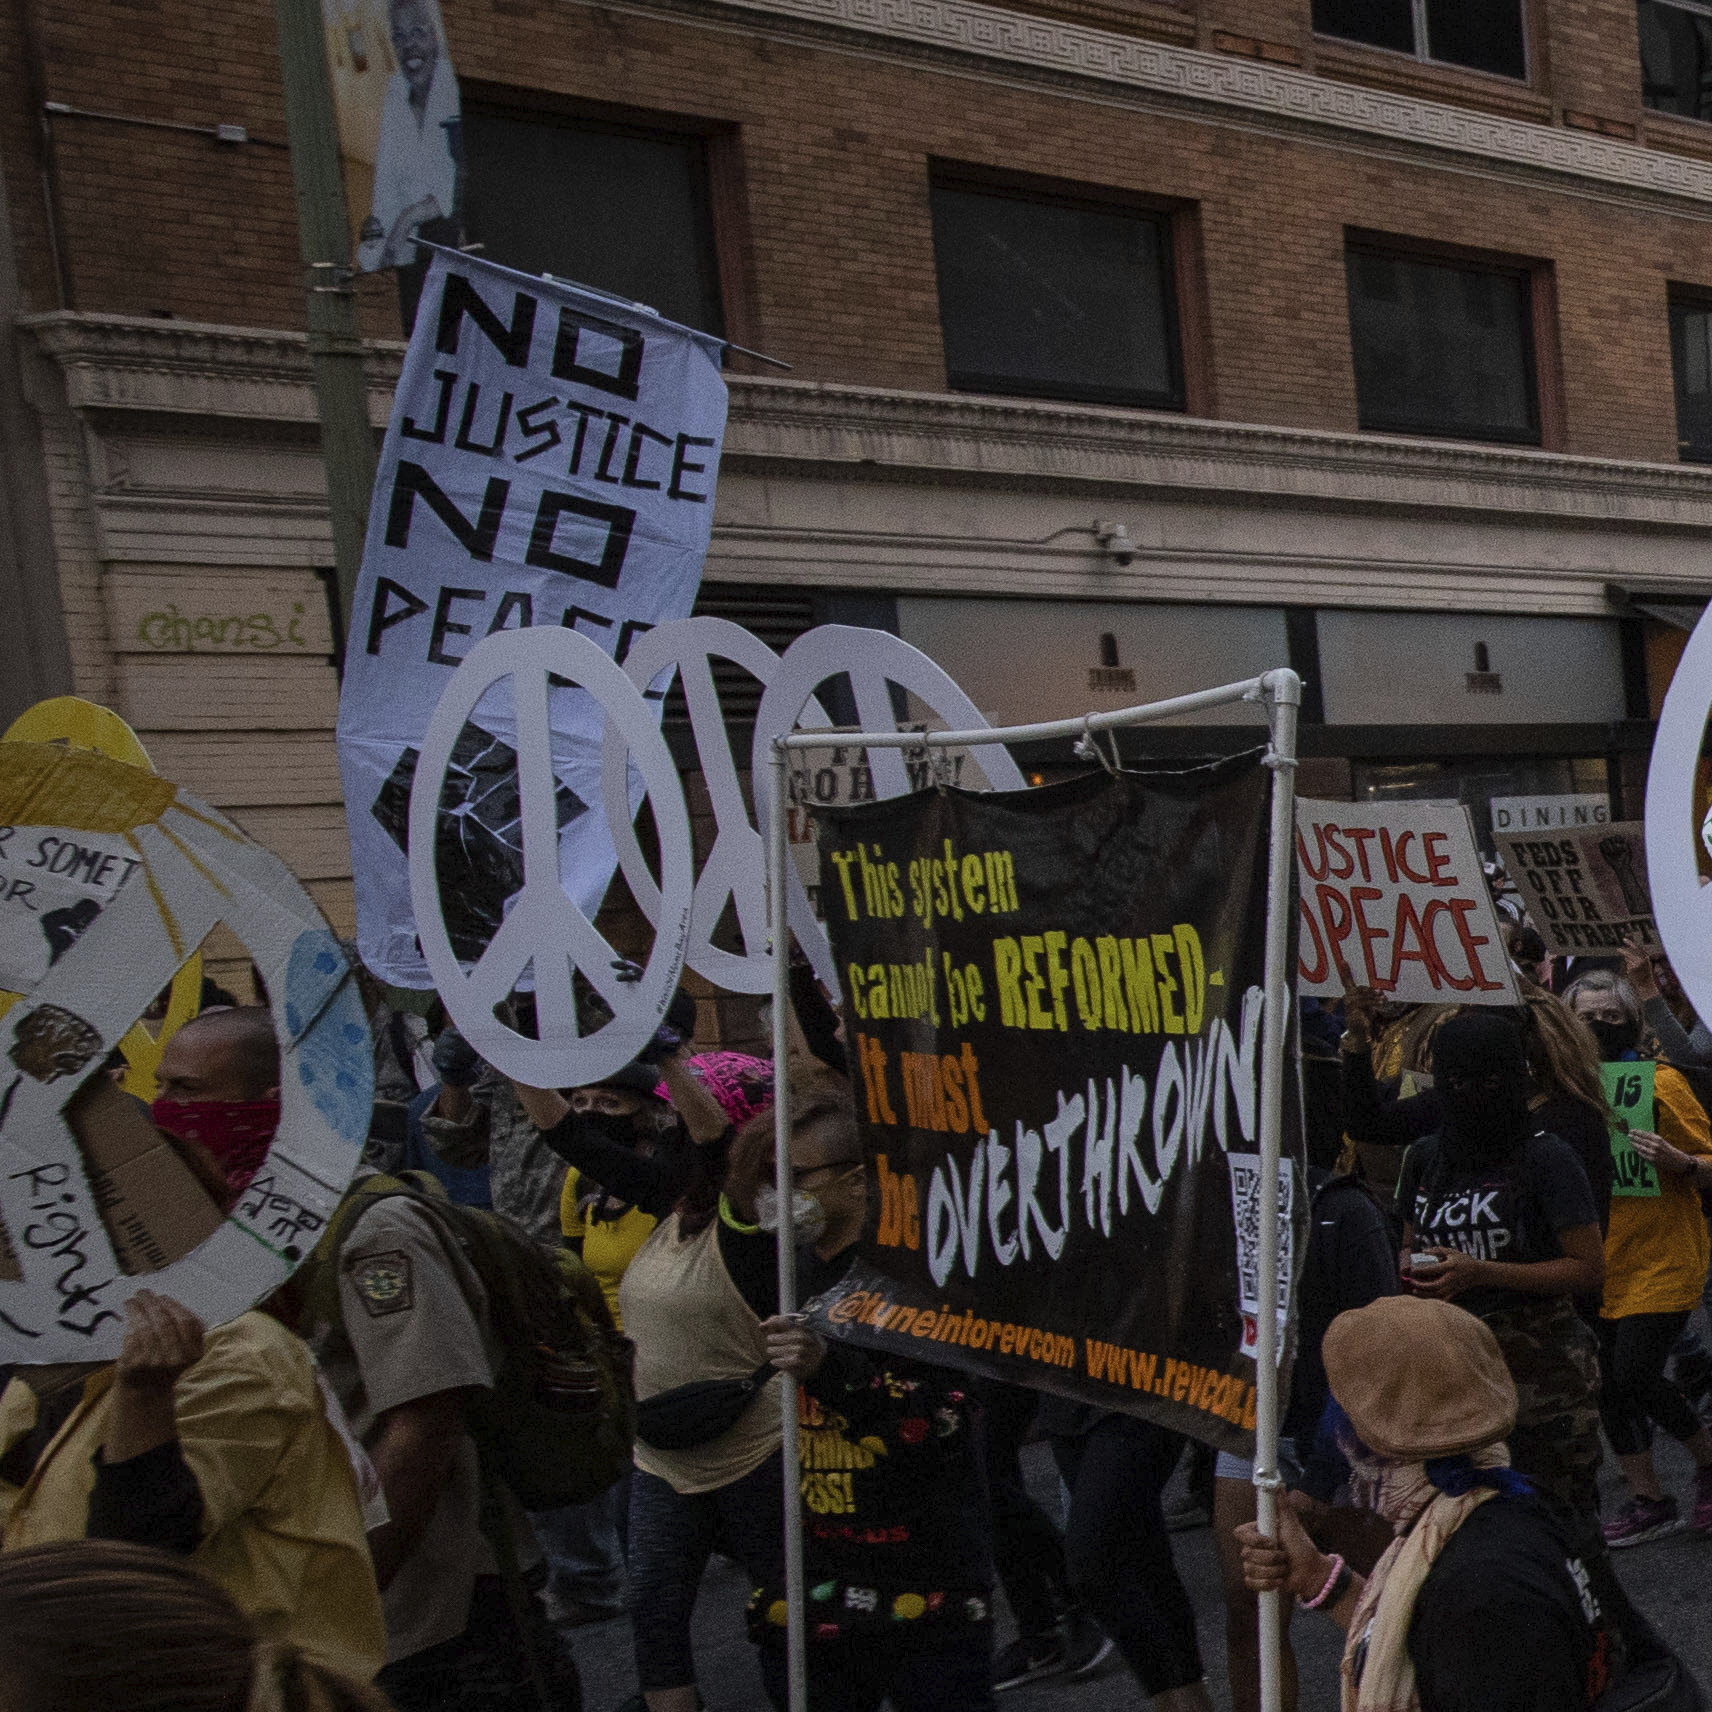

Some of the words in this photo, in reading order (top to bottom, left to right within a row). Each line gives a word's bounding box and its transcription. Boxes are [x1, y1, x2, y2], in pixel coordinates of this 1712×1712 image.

[436, 272, 645, 401] NO
[403, 373, 716, 504] JUSTICE
[385, 461, 637, 590] NO
[1297, 823, 1459, 887] USTICE
[1498, 805, 1607, 829] DINING
[1510, 841, 1580, 868] FEDS
[831, 842, 904, 921] This
[909, 838, 1019, 929] system
[1528, 869, 1584, 896] OFF
[1539, 896, 1602, 922] OUR
[1316, 884, 1505, 992] PEACE
[850, 951, 936, 1030] cannot
[944, 951, 985, 1029] be
[860, 1032, 897, 1126] It
[902, 1037, 990, 1137] must
[1614, 1073, 1641, 1108] IS
[876, 1153, 921, 1251] be
[925, 981, 1290, 1288] OVERTHROWN
[8, 1162, 123, 1337] Rights
[827, 1289, 1075, 1369] @tuneintorevcom
